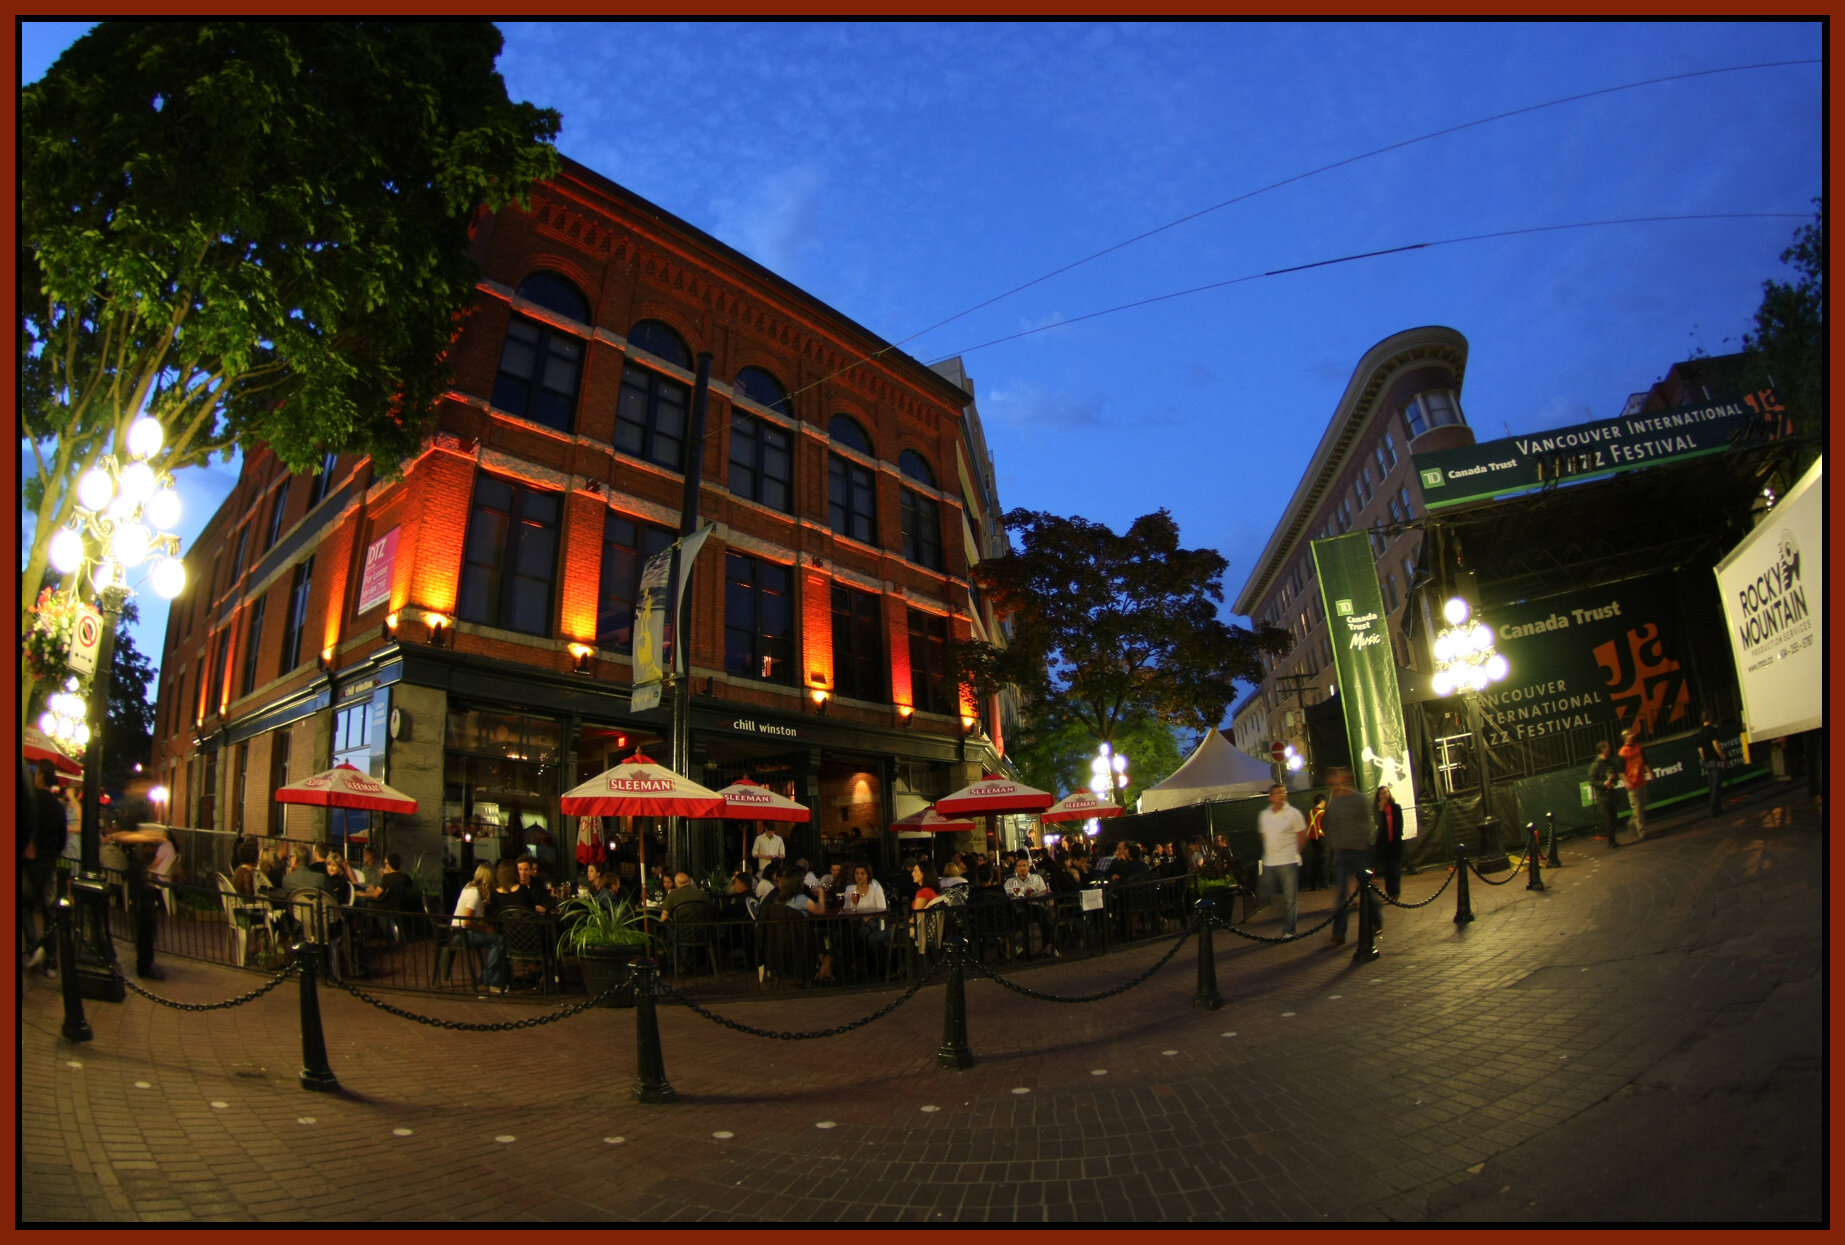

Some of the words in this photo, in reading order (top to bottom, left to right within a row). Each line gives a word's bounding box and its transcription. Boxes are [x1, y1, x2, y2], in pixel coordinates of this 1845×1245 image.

[1515, 425, 1622, 455] VANCOUVER
[1626, 403, 1744, 435] INTERNATIONAL
[1609, 434, 1697, 463] FESTIVAL
[1448, 464, 1488, 479] Canada
[1488, 458, 1518, 474] Trust
[1422, 470, 1444, 486] TD
[1739, 562, 1783, 619] ROCKY
[1346, 612, 1378, 623] Canada
[1347, 621, 1371, 631] Trust
[1500, 613, 1570, 640] Canada
[1571, 600, 1622, 625] Trust
[1739, 585, 1809, 651] MOUNTAIN
[1349, 632, 1380, 651] Music
[733, 719, 755, 731] chill
[759, 723, 797, 737] winston
[1516, 712, 1593, 740] FESTIVAL
[1652, 761, 1684, 778] Trust
[610, 779, 672, 791] SLEEMAN
[970, 785, 1014, 795] SLEEMAN
[724, 793, 770, 803] SLEEMAN
[1065, 800, 1097, 809] SLEEMAN
